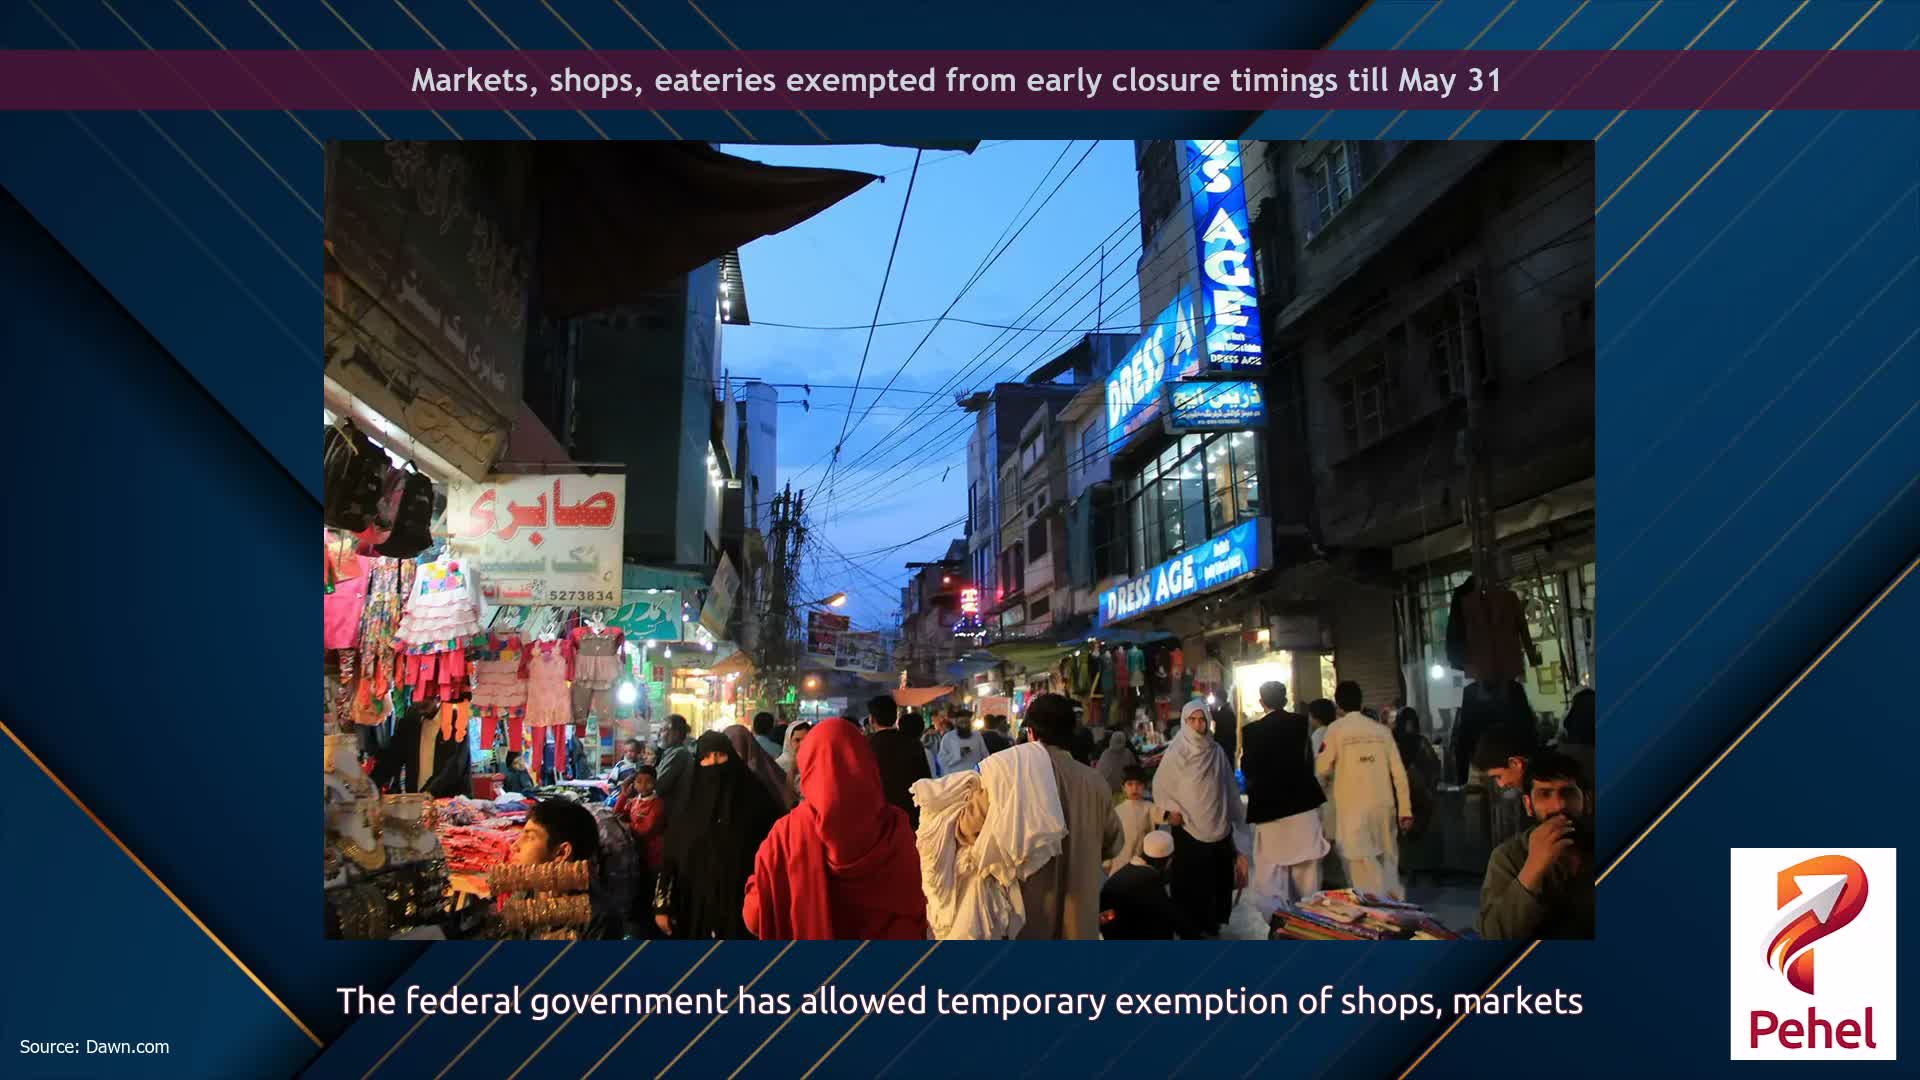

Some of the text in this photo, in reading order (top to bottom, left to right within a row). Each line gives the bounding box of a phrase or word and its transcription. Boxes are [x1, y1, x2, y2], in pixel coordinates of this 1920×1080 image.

[1202, 207, 1257, 327] AGE
[1108, 324, 1165, 429] DRESS
[456, 478, 616, 547] صابری
[550, 591, 614, 601] 5273834
[1107, 575, 1151, 620] DRESS
[1155, 554, 1194, 602] AGE
